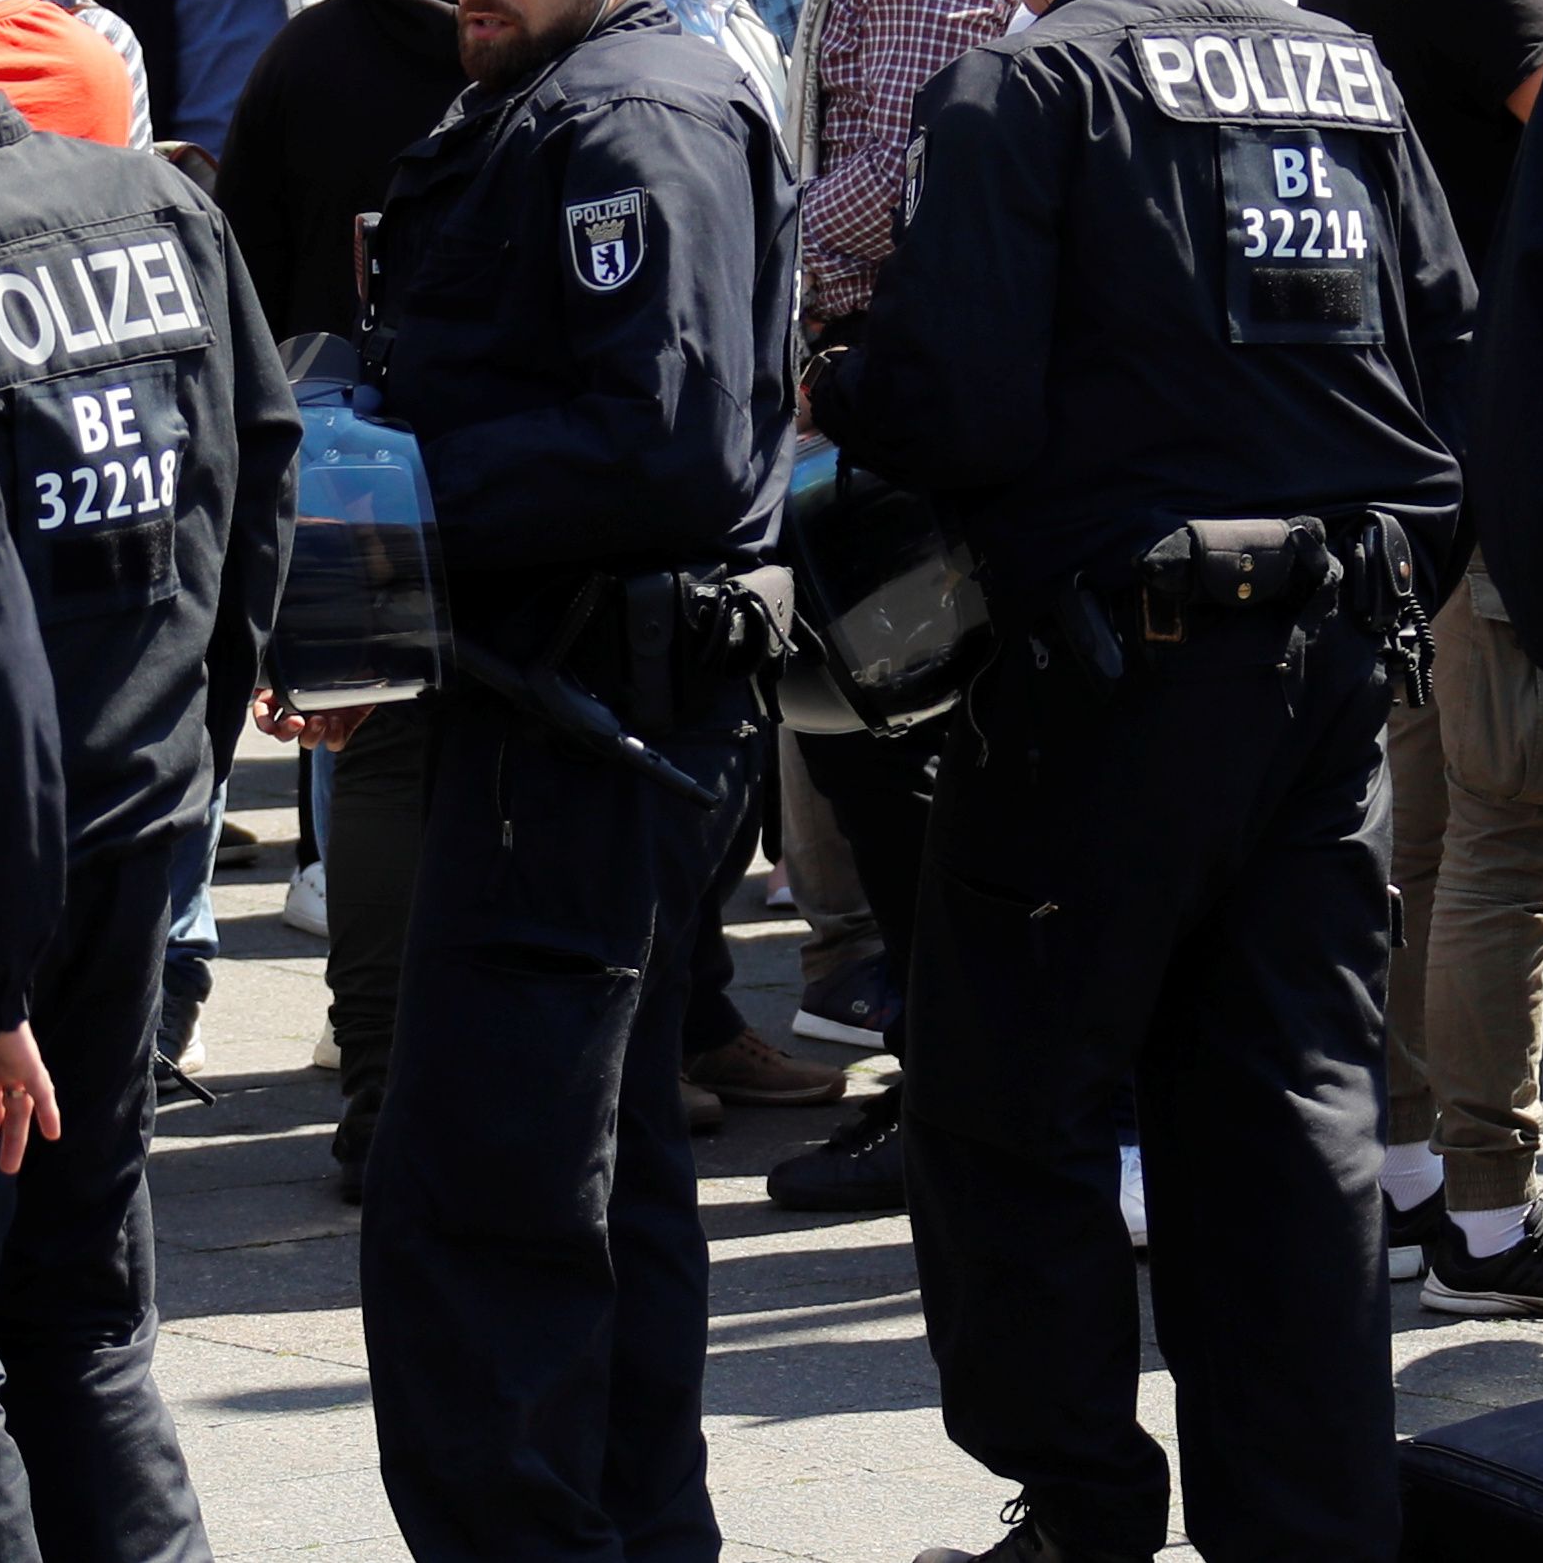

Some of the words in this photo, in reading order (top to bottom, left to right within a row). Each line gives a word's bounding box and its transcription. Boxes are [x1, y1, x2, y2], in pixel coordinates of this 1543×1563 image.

[1142, 36, 1391, 121] POLIZEI
[1272, 147, 1333, 199] BE
[572, 197, 635, 226] POLIZEI
[1242, 208, 1368, 259] 32214
[71, 386, 142, 454] BE
[35, 449, 177, 531] 32218
